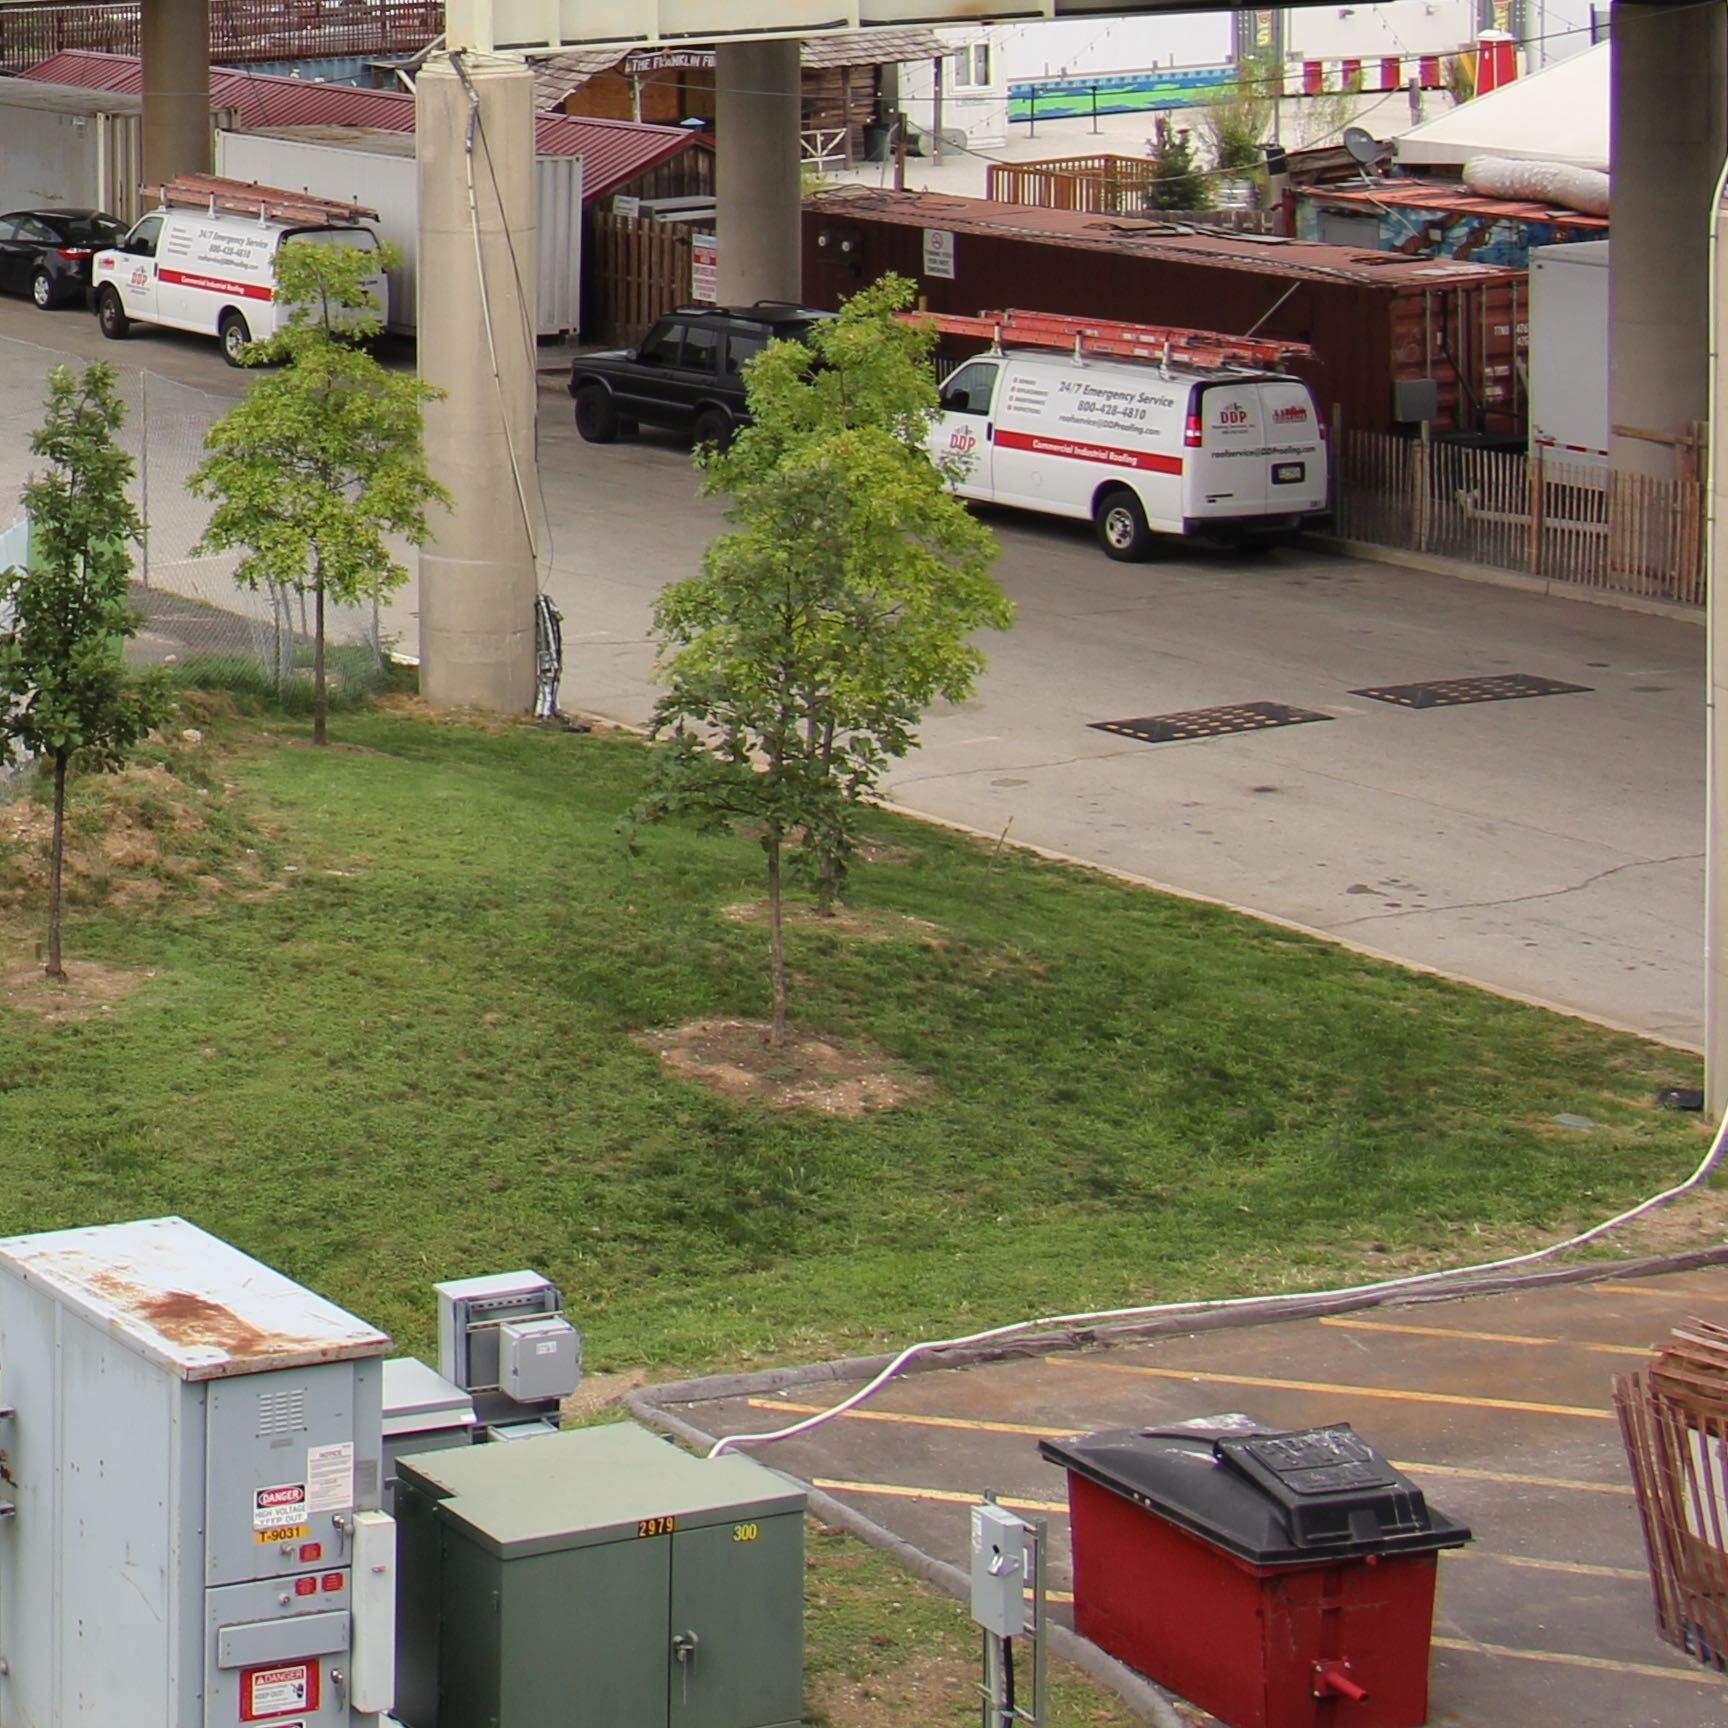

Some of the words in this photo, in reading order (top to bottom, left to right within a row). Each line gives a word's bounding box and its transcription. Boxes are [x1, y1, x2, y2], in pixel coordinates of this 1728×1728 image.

[632, 58, 652, 72] THE
[1058, 380, 1082, 394] 24/7
[1082, 384, 1137, 404] Emergency
[1137, 392, 1175, 408] Service
[1077, 399, 1147, 421] 800-428-4810
[1221, 411, 1248, 424] DDP
[950, 433, 976, 453] DDP
[1032, 438, 1075, 454] Commercial
[1074, 444, 1108, 460] Industrial
[1109, 450, 1139, 467] Roofing
[262, 1487, 300, 1505] DANGER
[275, 1504, 306, 1517] VOLTAGE
[284, 1513, 303, 1524] OUT
[259, 1526, 301, 1543] T-9031
[639, 1517, 674, 1538] 2979
[732, 1522, 758, 1542] 300
[264, 1669, 303, 1684] DANGER
